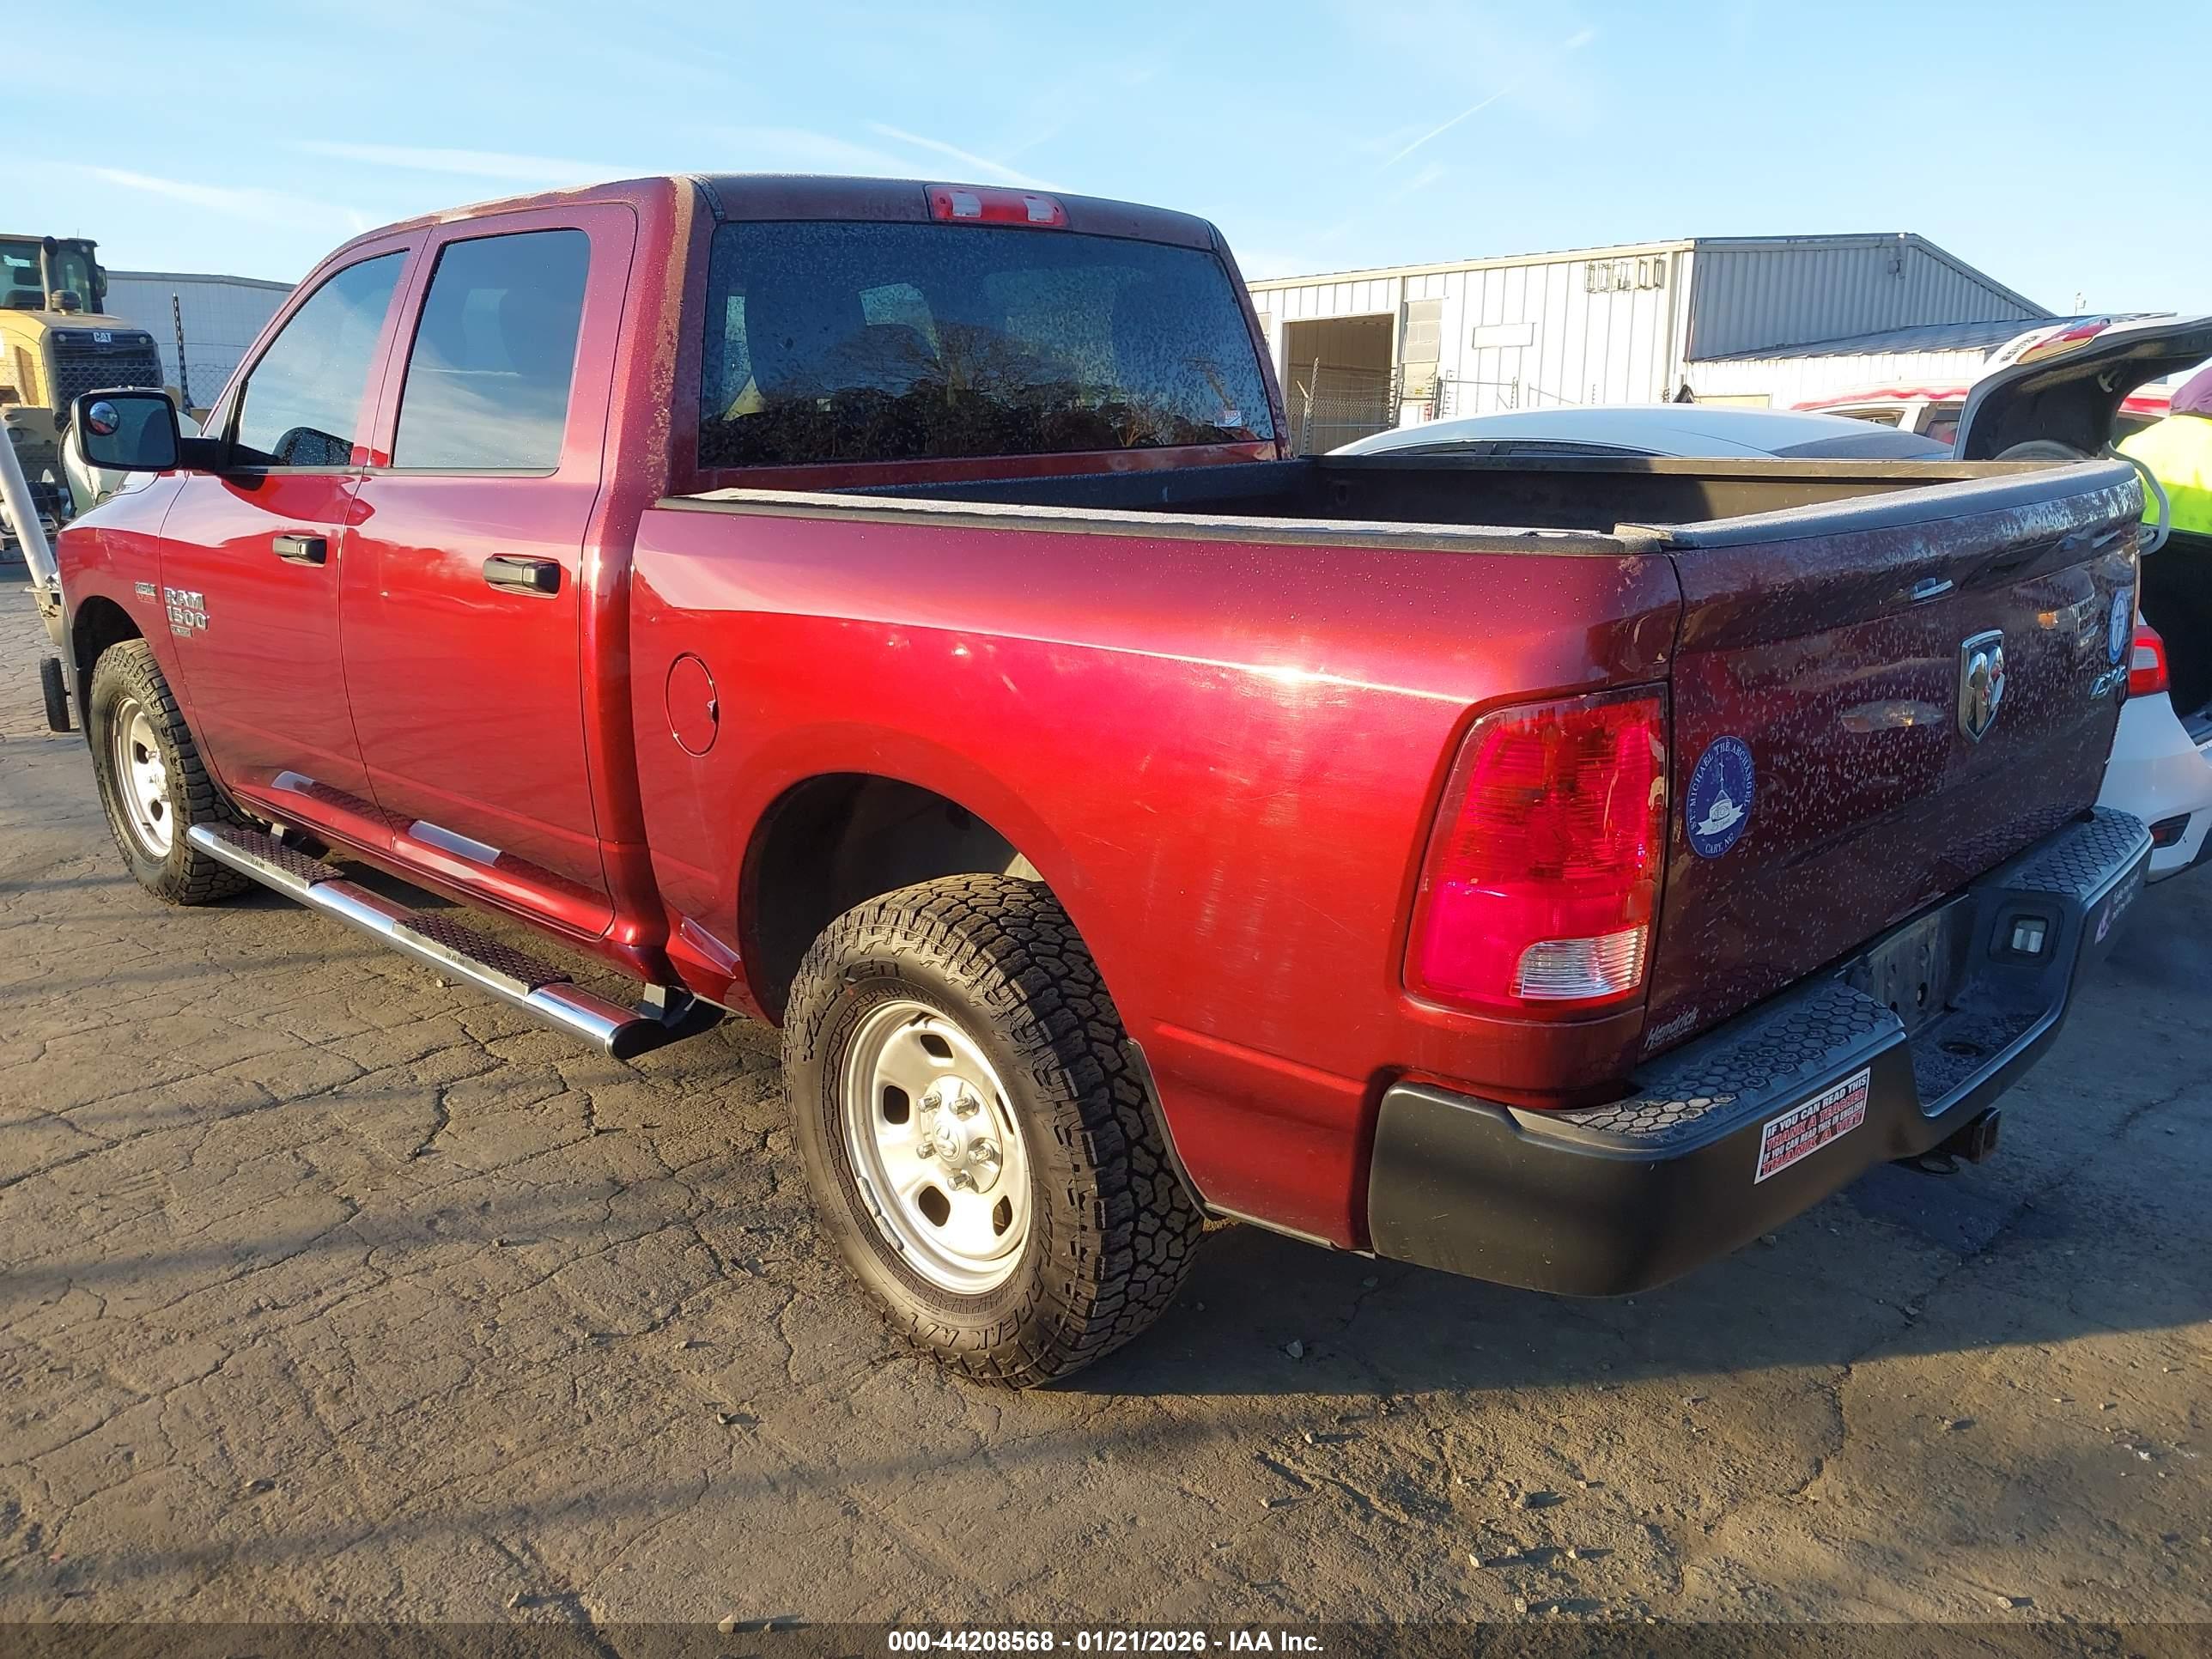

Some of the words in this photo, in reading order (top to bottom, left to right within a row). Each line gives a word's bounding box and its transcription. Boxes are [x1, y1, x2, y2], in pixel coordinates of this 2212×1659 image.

[93, 331, 112, 343] CAT
[164, 587, 205, 611] RAM
[167, 605, 208, 630] 1500
[1690, 752, 1714, 808] MICHAEL
[1715, 742, 1730, 756] THE
[1732, 744, 1753, 807] ARCHANGEL
[1724, 832, 1735, 848] NC
[1763, 1151, 1771, 1163] IF
[1771, 1145, 1784, 1158] YOU
[1785, 1136, 1799, 1151] CAN
[1800, 1127, 1817, 1144] READ
[1818, 1120, 1832, 1133] THIS
[1832, 1115, 1839, 1126] IN
[1839, 1100, 1863, 1121] ENGLISH
[1766, 1120, 1807, 1152] THANK
[1808, 1115, 1817, 1129] A
[1820, 1087, 1865, 1121] TEACHER
[1767, 1126, 1778, 1139] IF
[1779, 1114, 1798, 1133] YOU
[1800, 1103, 1820, 1121] CAN
[1822, 1088, 1845, 1109] READ
[1847, 1075, 1867, 1092] THIS
[1762, 1135, 1819, 1175] THANK
[1820, 1127, 1832, 1143] A
[1836, 1111, 1863, 1133] VET
